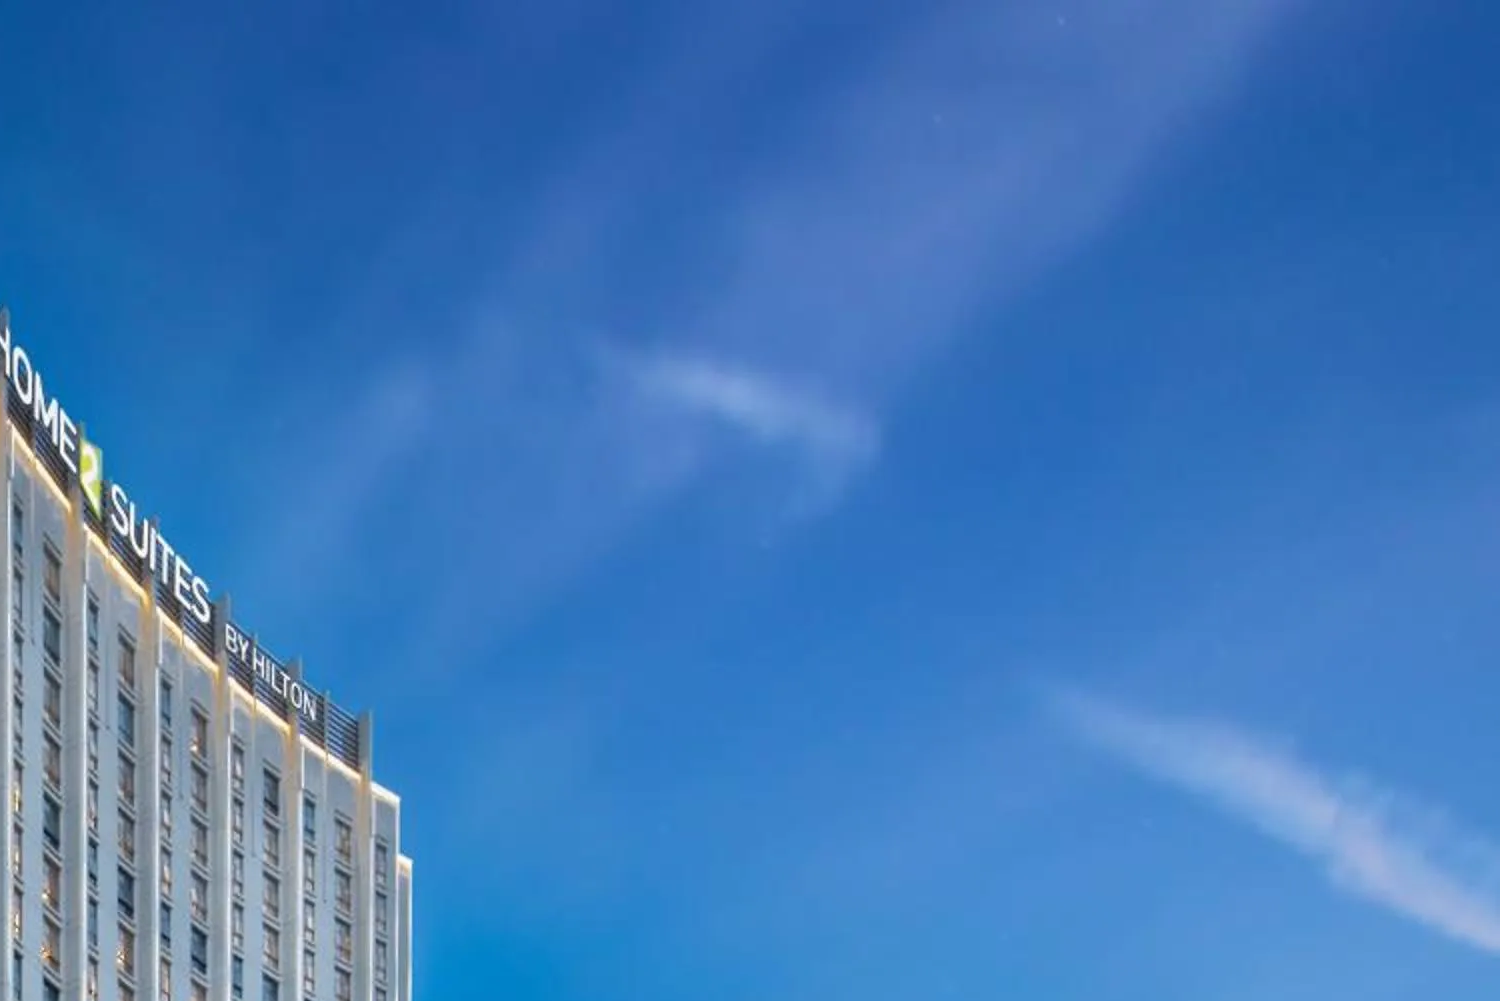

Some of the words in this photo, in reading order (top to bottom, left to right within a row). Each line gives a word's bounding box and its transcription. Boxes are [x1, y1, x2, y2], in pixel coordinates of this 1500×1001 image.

[110, 483, 211, 624] SUITES
[224, 623, 251, 663] BY
[252, 650, 317, 721] HILTON
